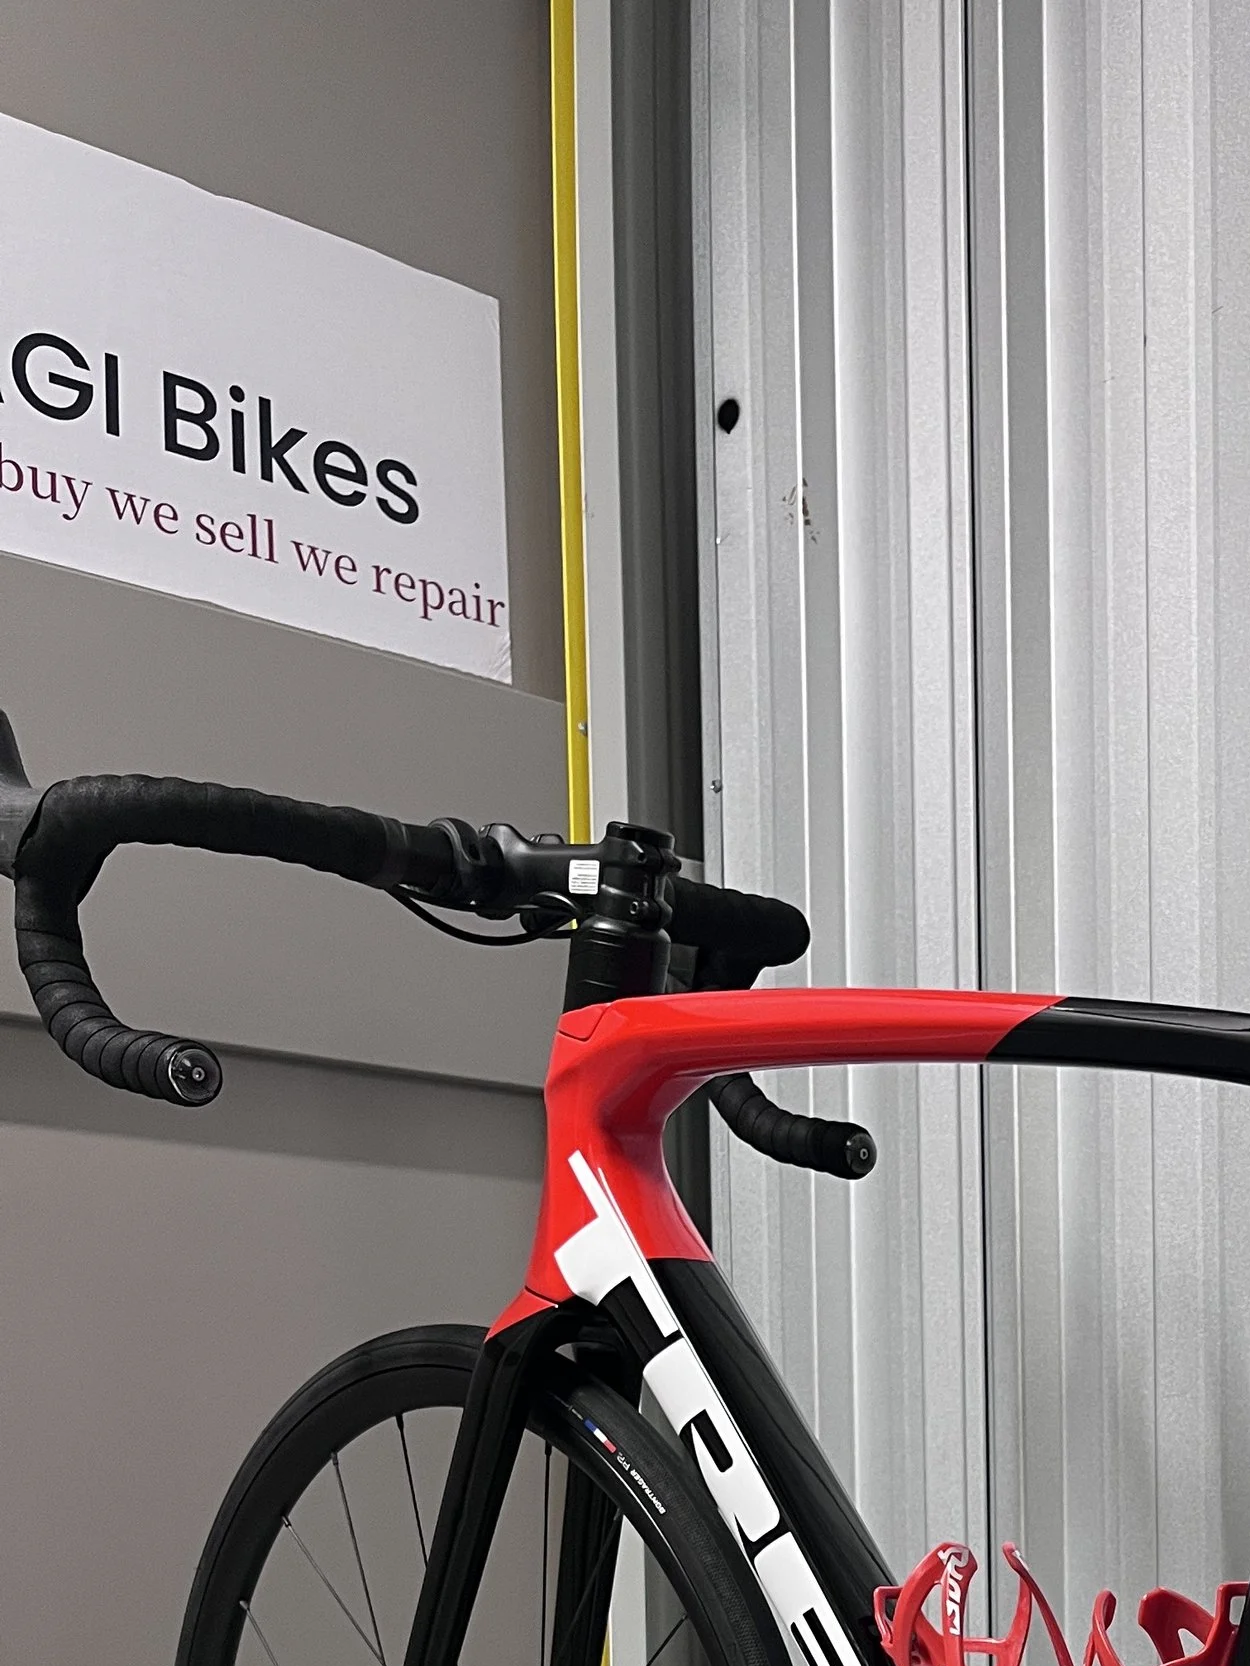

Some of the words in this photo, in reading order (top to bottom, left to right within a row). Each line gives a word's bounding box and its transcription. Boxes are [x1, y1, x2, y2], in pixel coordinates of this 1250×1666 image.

[0, 332, 120, 437] GI
[163, 371, 420, 524] Bikes
[0, 441, 93, 520] buy
[106, 487, 180, 535] we
[194, 513, 279, 563] sell
[290, 539, 358, 585] we
[371, 564, 506, 628] repair
[630, 1469, 666, 1514] BONTRAGER
